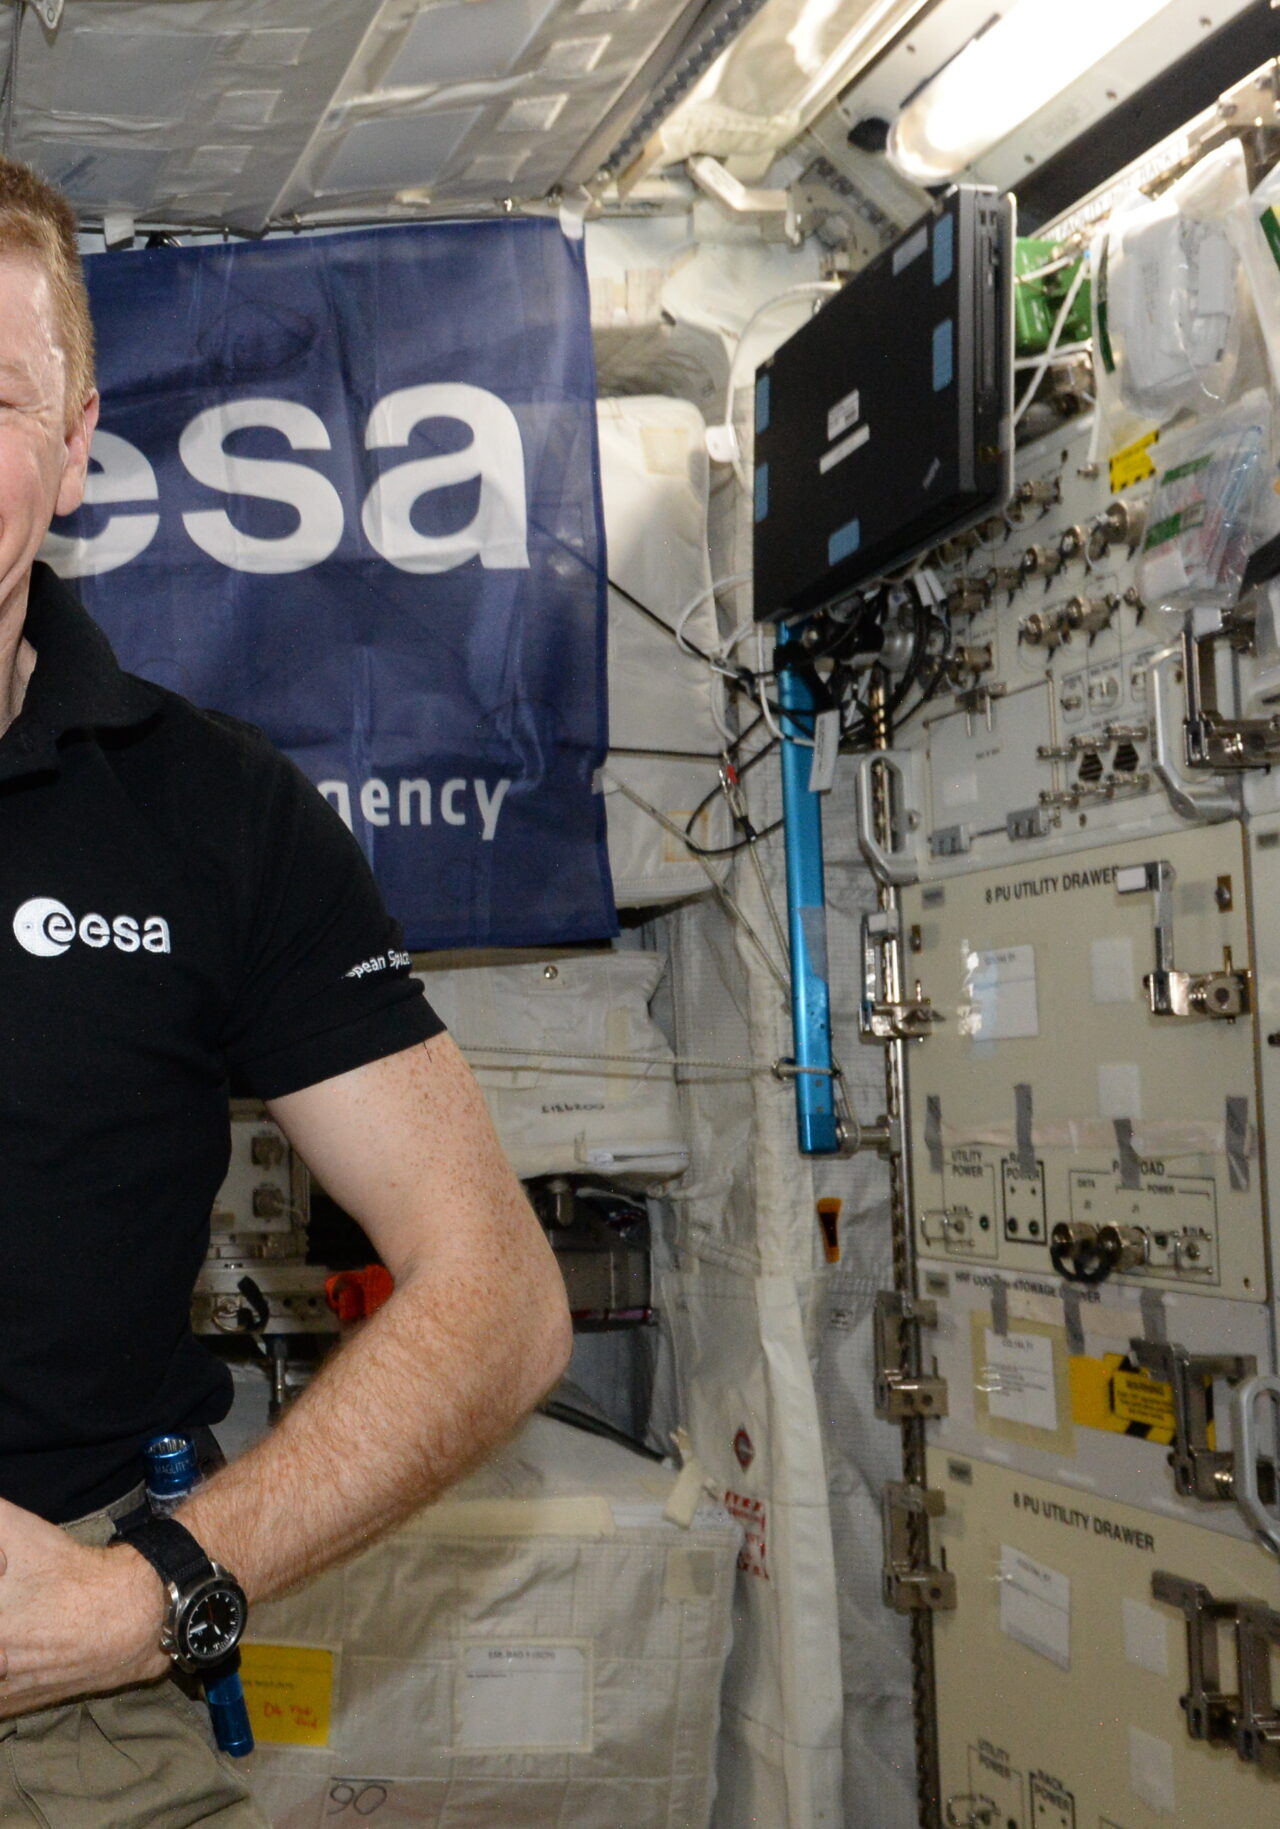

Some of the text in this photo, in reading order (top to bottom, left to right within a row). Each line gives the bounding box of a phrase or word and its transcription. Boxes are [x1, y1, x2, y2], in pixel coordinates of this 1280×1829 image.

[985, 887, 993, 905] 8
[995, 886, 1011, 902] PU
[1013, 876, 1058, 900] UTILITY
[952, 1165, 983, 1178] POWER
[1023, 1494, 1040, 1515] PU
[1042, 1501, 1091, 1530] UTILITY
[1093, 1516, 1155, 1552] DRAWER
